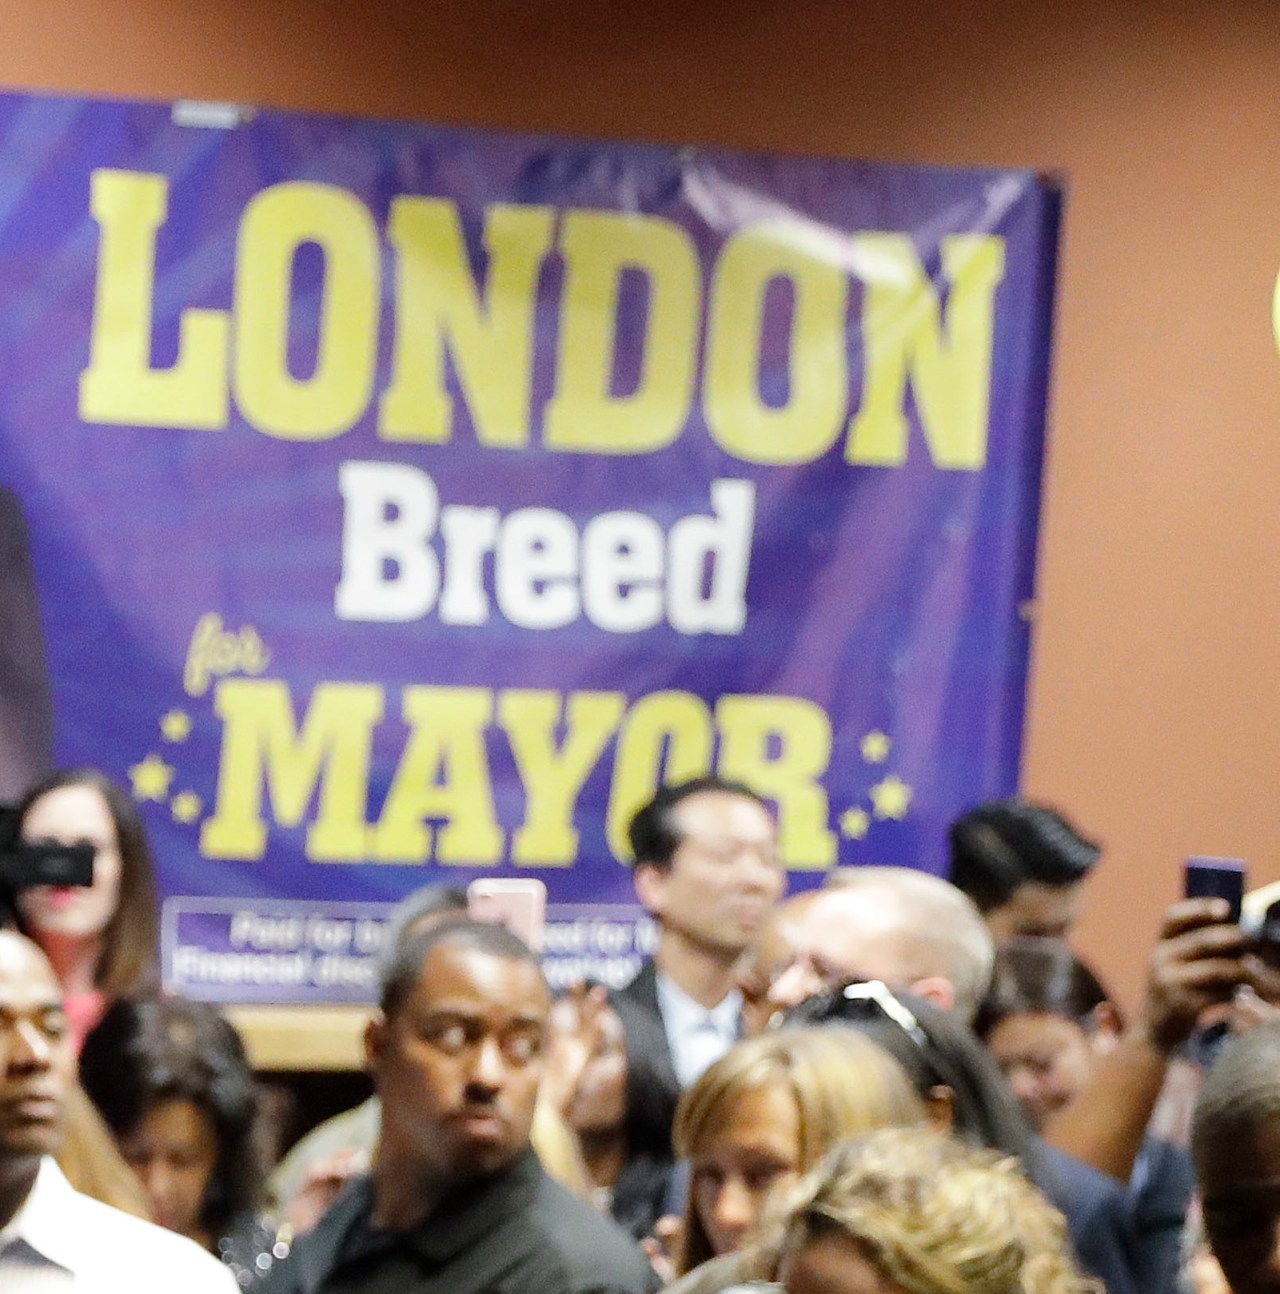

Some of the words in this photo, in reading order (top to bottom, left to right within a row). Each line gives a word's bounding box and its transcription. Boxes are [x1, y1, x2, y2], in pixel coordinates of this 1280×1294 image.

[78, 168, 1005, 470] LONDON
[334, 460, 756, 635] Breed
[183, 612, 271, 696] for
[200, 676, 838, 868] MAYOR
